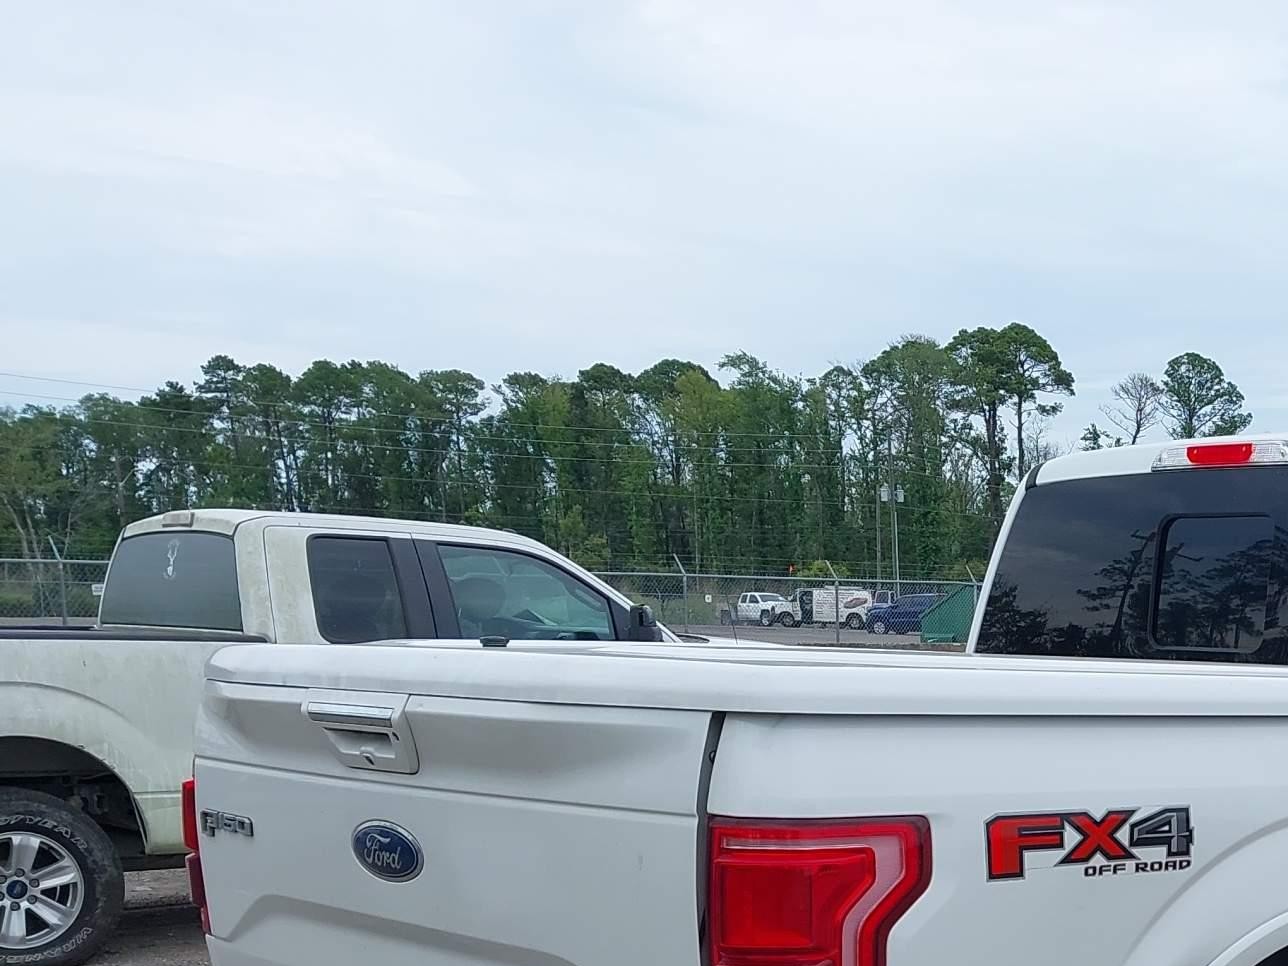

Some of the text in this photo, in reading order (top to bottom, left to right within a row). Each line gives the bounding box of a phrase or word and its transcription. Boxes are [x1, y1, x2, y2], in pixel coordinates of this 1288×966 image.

[363, 833, 402, 869] Ford
[985, 806, 1194, 880] FX4
[1084, 859, 1192, 877] OFF ROAD
